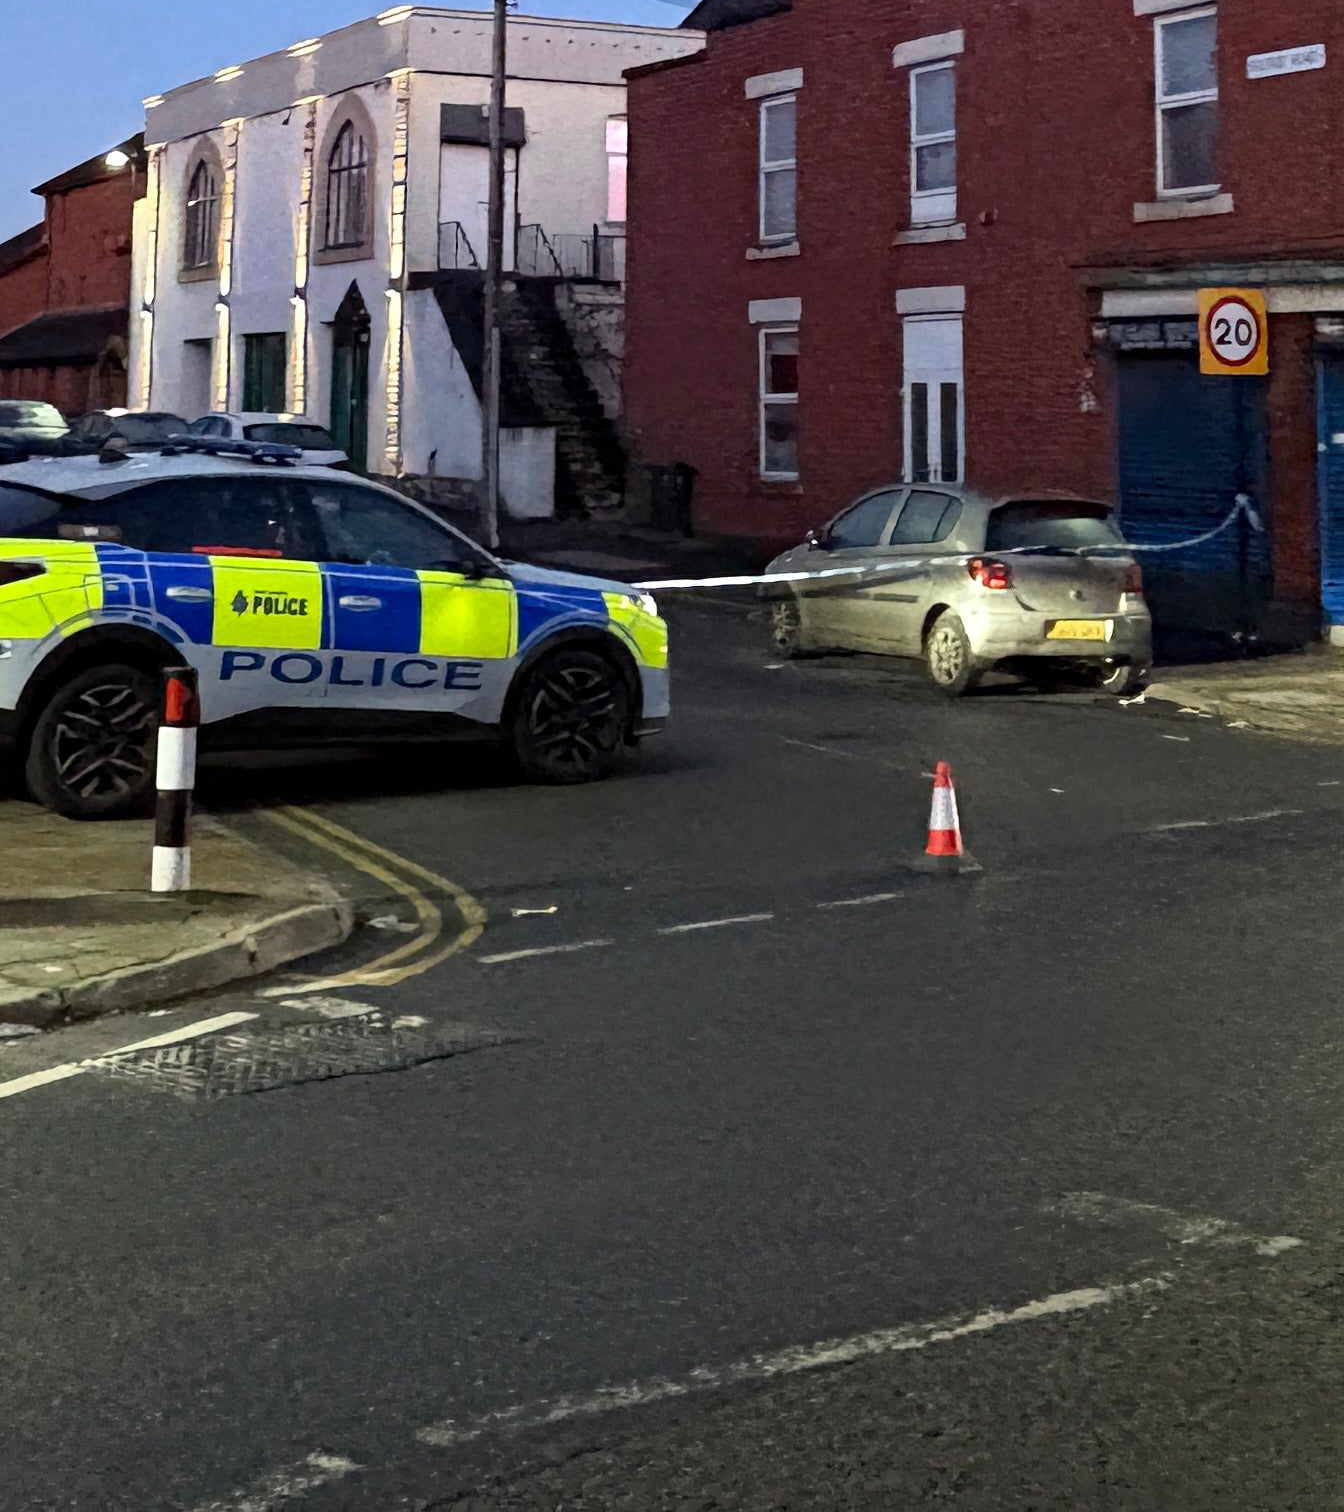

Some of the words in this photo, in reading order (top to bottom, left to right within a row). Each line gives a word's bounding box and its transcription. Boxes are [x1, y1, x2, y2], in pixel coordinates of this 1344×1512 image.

[1214, 318, 1252, 346] 20
[252, 595, 308, 617] POLICE
[219, 650, 484, 691] POLICE
